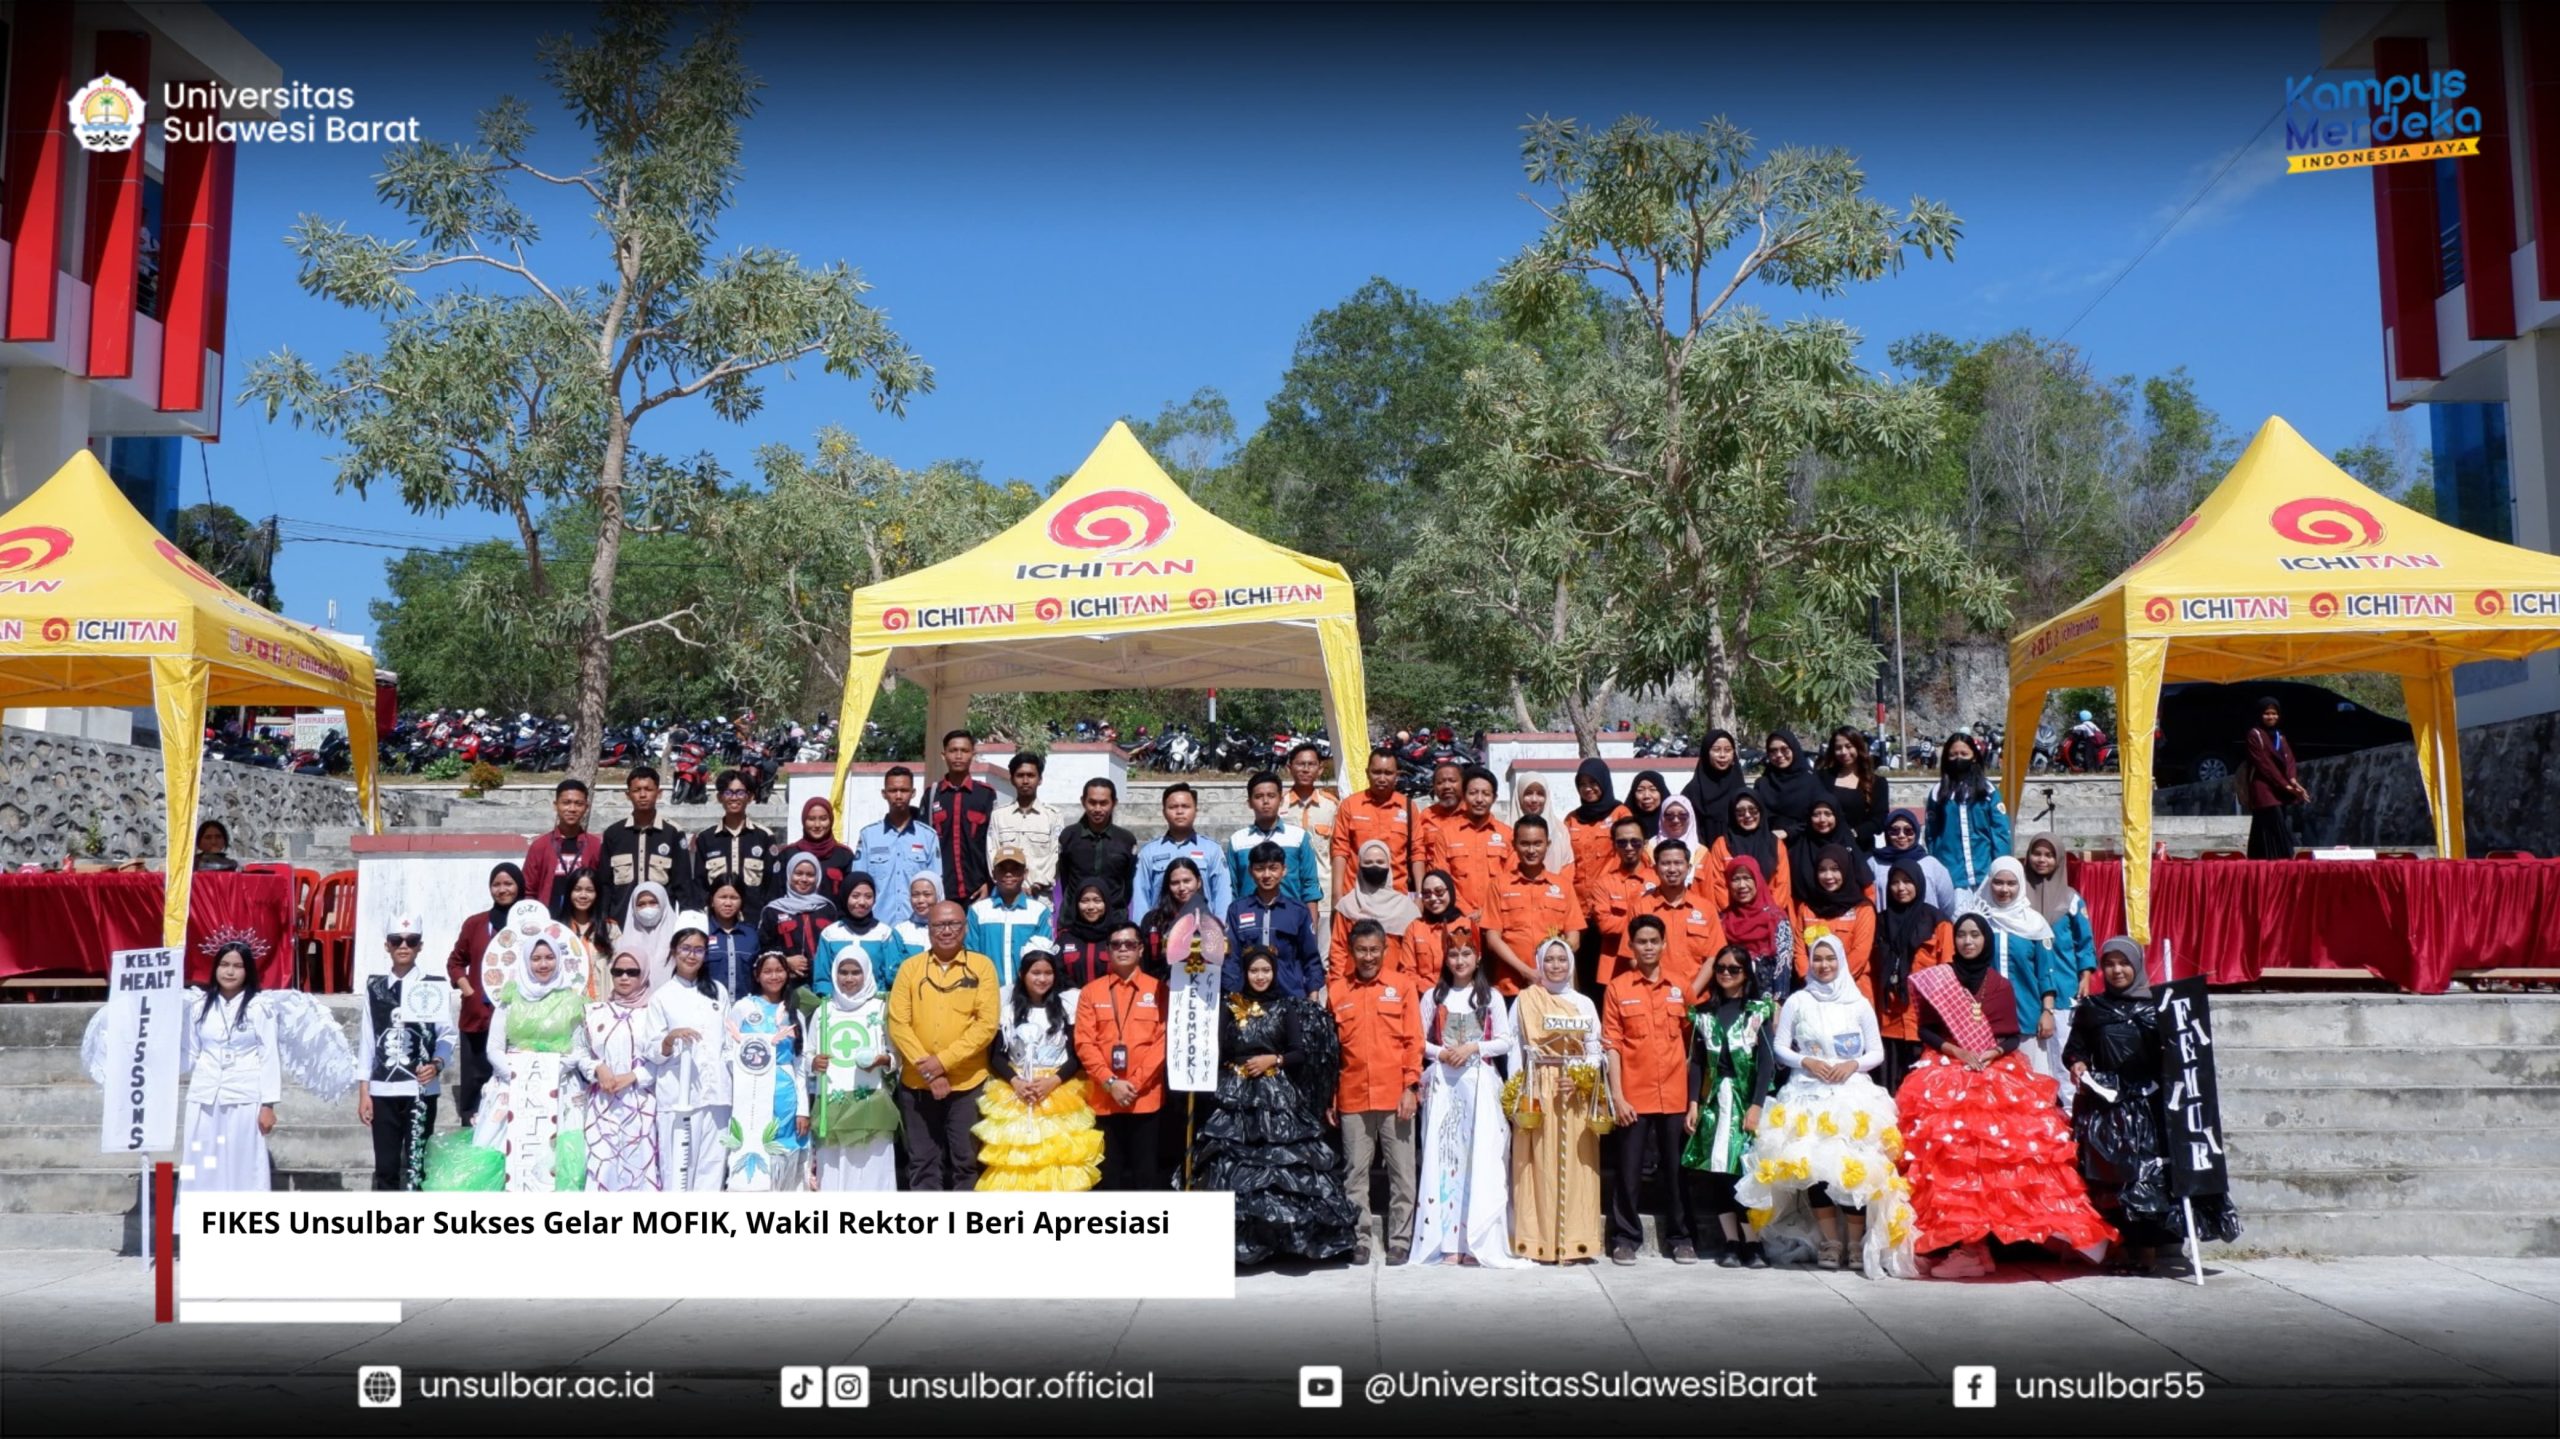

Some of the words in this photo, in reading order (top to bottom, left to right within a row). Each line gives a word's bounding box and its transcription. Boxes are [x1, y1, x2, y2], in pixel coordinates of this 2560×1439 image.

[1016, 558, 1194, 580] ICHITAN
[2280, 554, 2440, 571] ICHITAN
[0, 580, 62, 593] AN
[1225, 584, 1322, 607] ICHITAN
[917, 604, 1014, 628] ICHITAN
[1071, 594, 1168, 618] ICHITAN
[2182, 598, 2287, 619] ICHITAN
[2347, 594, 2453, 616] ICHITAN
[77, 620, 177, 641] ICHITAN
[516, 904, 538, 915] GIZI
[120, 969, 175, 991] HEALT
[1545, 1016, 1591, 1030] SALUS
[2172, 998, 2212, 1171] FEMUR
